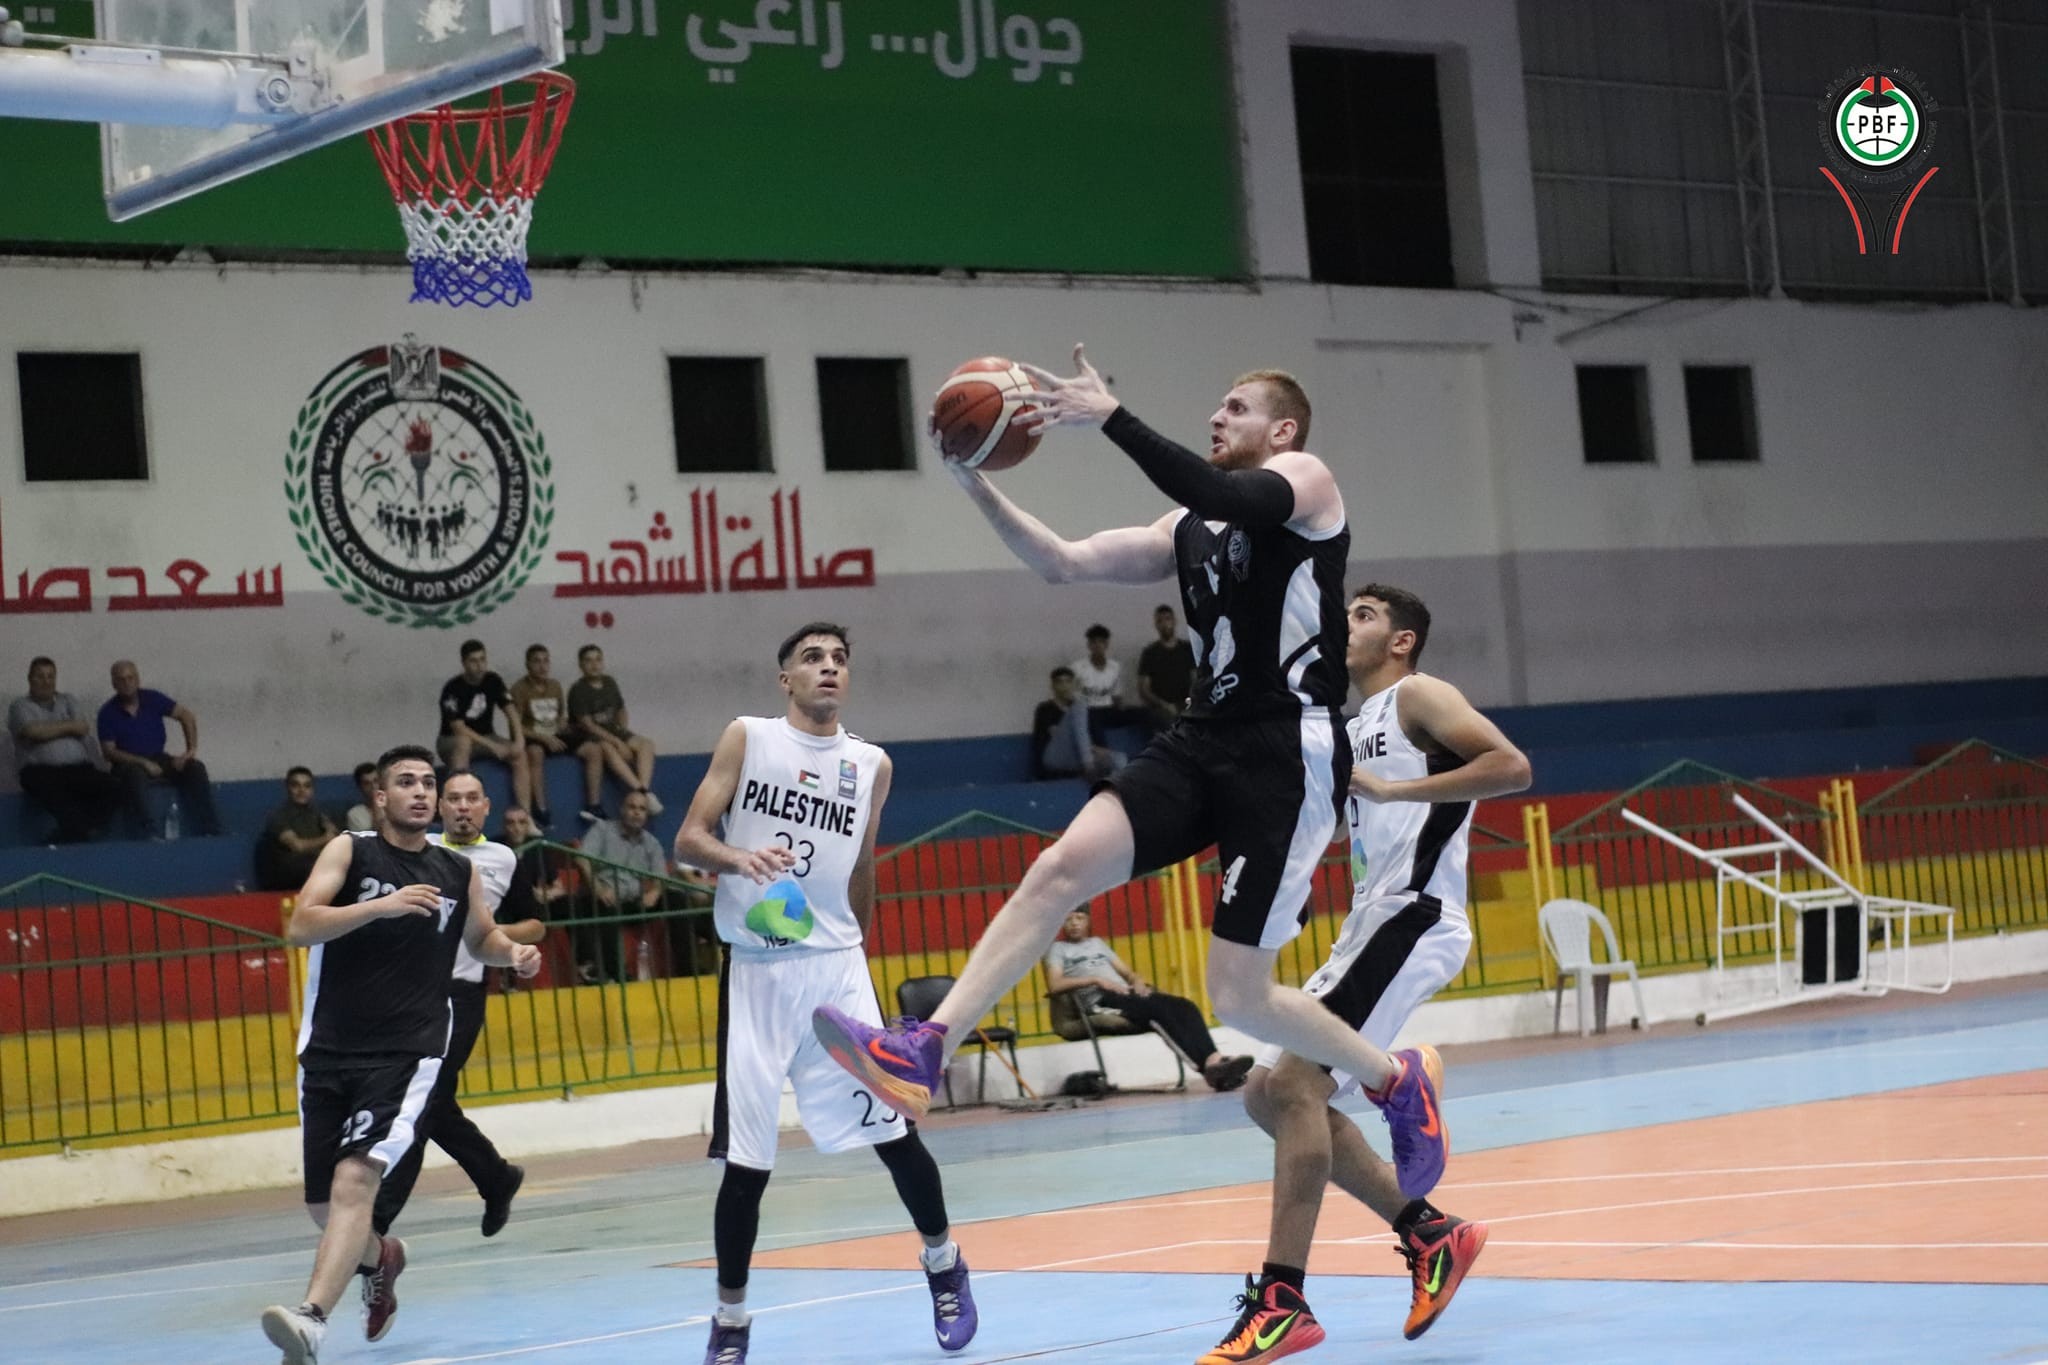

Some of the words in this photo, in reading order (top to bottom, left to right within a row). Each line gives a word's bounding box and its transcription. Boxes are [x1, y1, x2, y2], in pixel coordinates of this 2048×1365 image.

[107, 558, 284, 612] سعد
[318, 474, 348, 543] HIGHER
[341, 541, 409, 596] COUNCIL
[412, 581, 447, 599] FOR
[449, 554, 501, 594] YOUTH
[501, 475, 523, 541] SPORTS
[553, 486, 718, 629] الشهيد
[729, 486, 875, 592] صالة
[742, 779, 857, 837] PALESTINE
